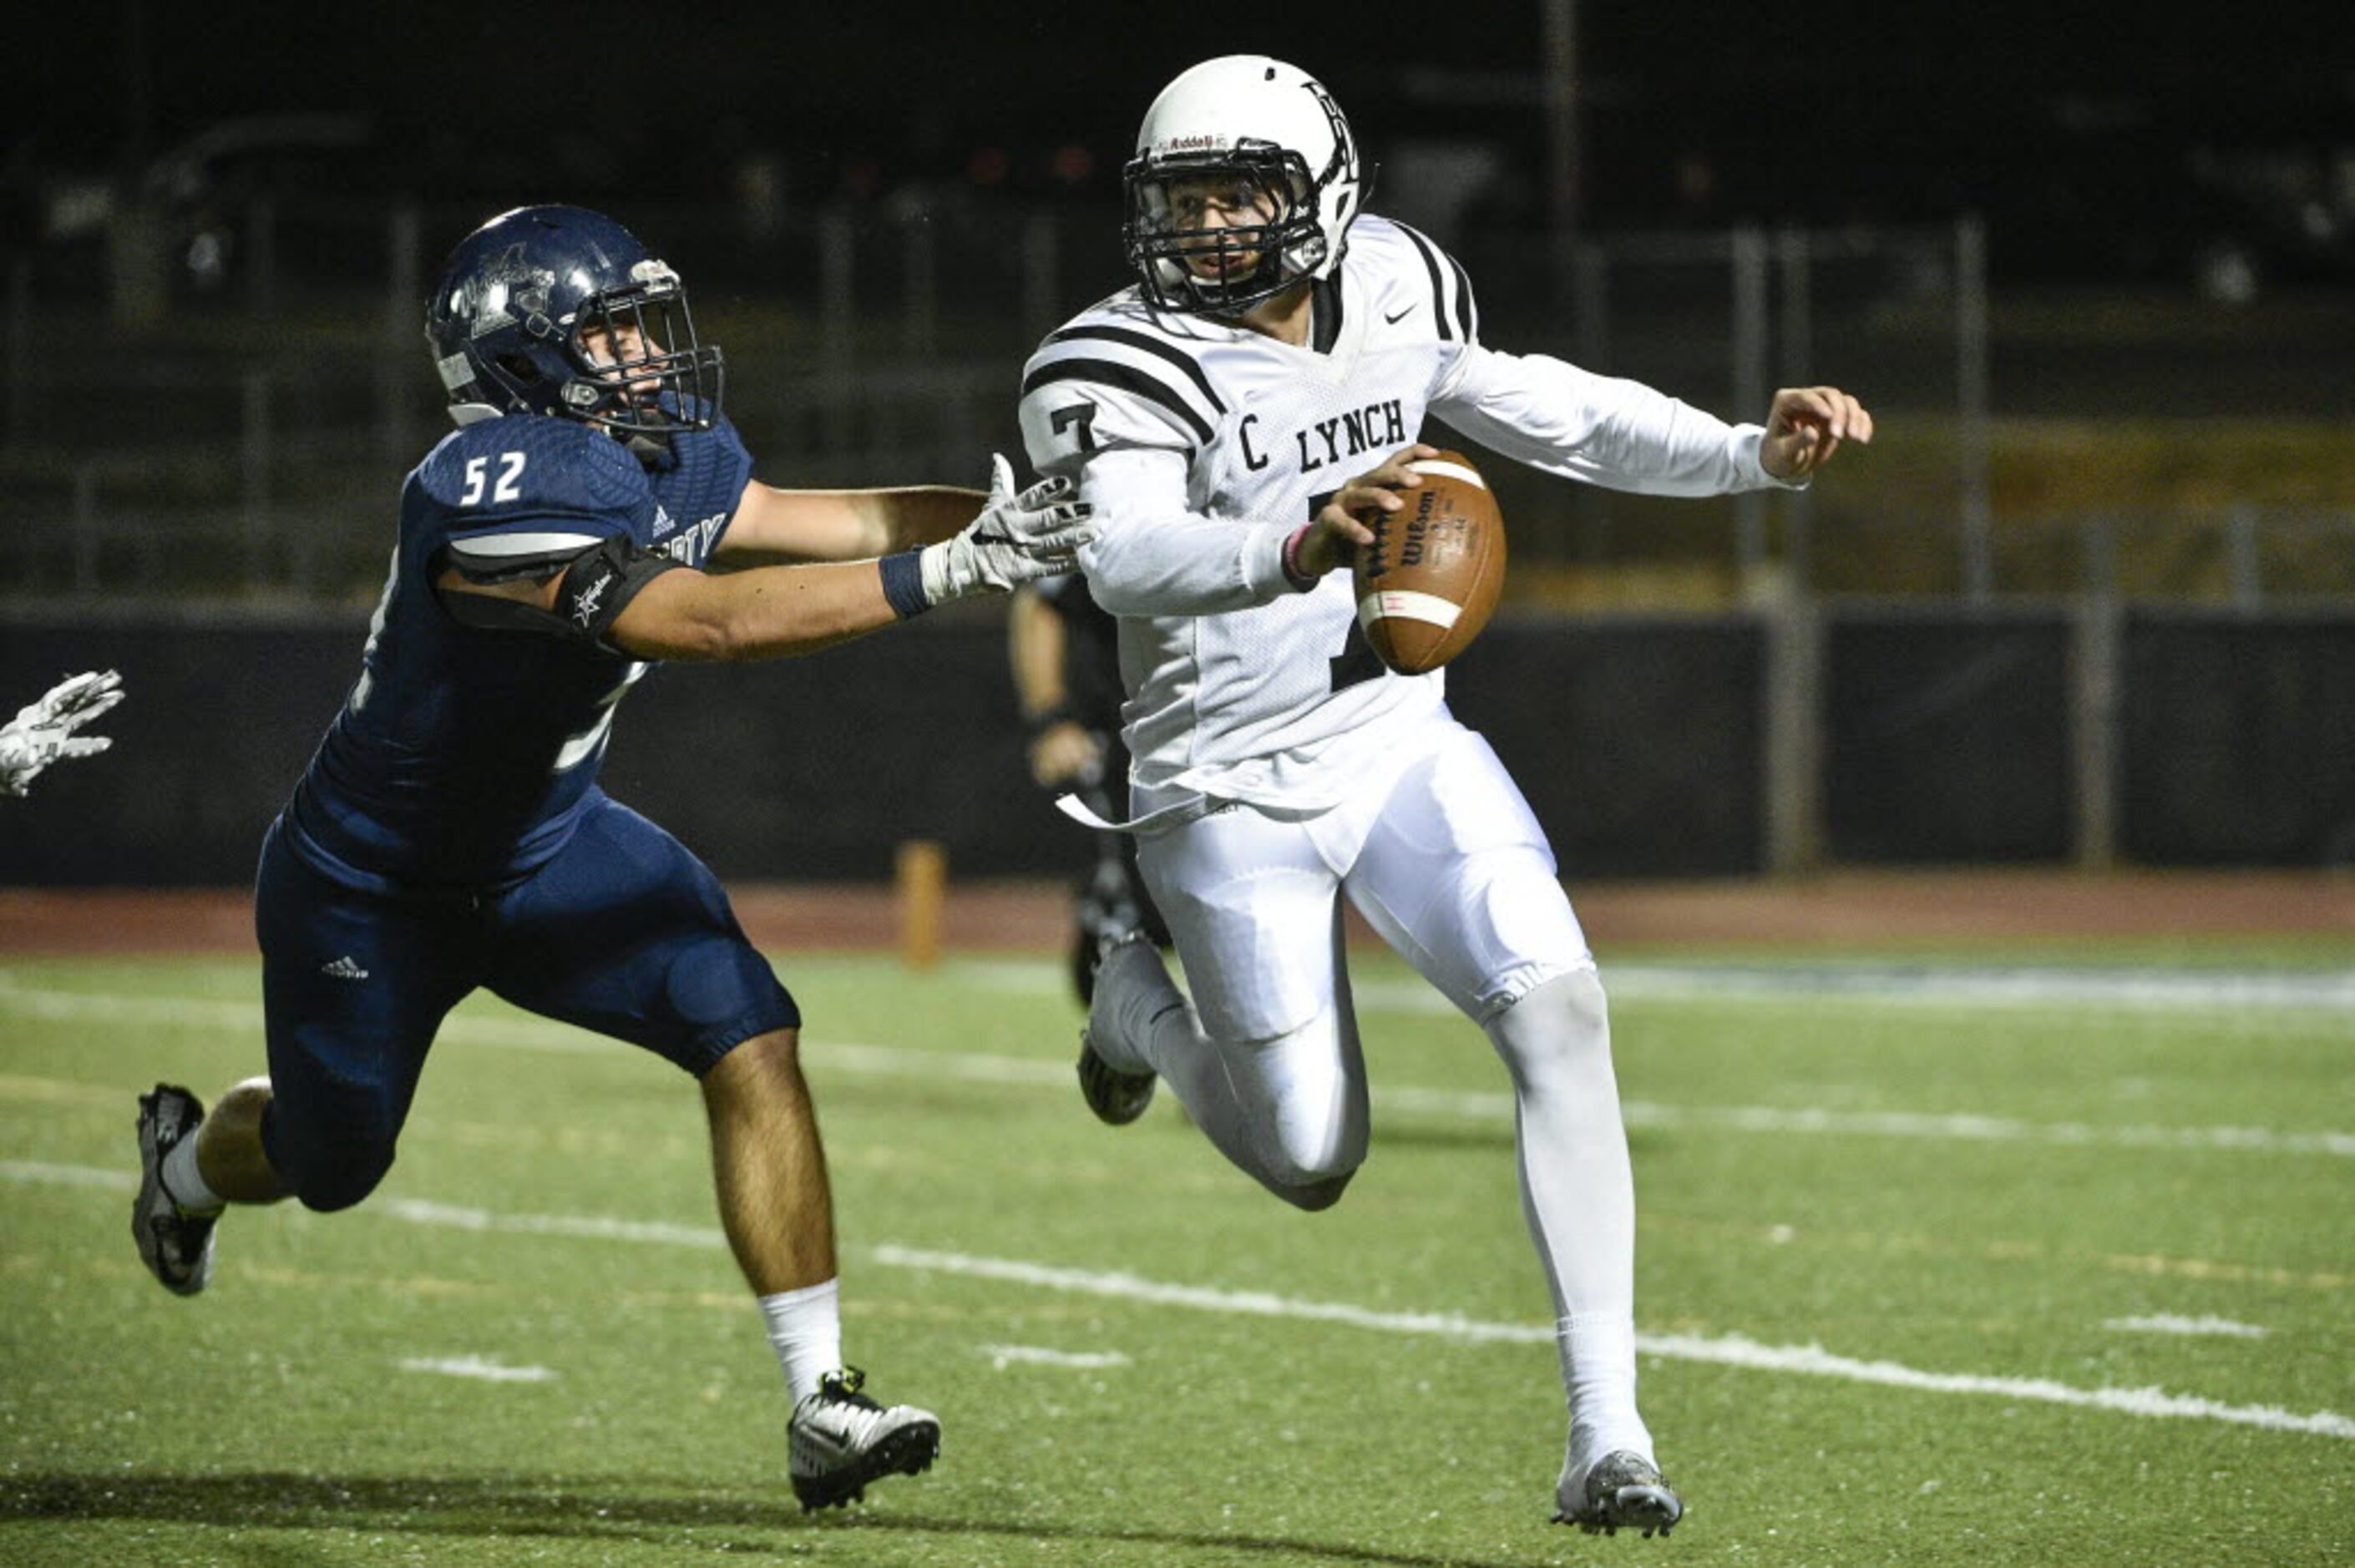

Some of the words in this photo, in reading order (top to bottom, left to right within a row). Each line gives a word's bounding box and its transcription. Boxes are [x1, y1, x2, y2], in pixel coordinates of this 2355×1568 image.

[1051, 402, 1096, 453] 7
[1239, 413, 1269, 472] C
[1296, 399, 1405, 473] LYNCH
[459, 451, 526, 506] 52
[662, 512, 727, 566] RTY
[1400, 491, 1436, 566] Wilson
